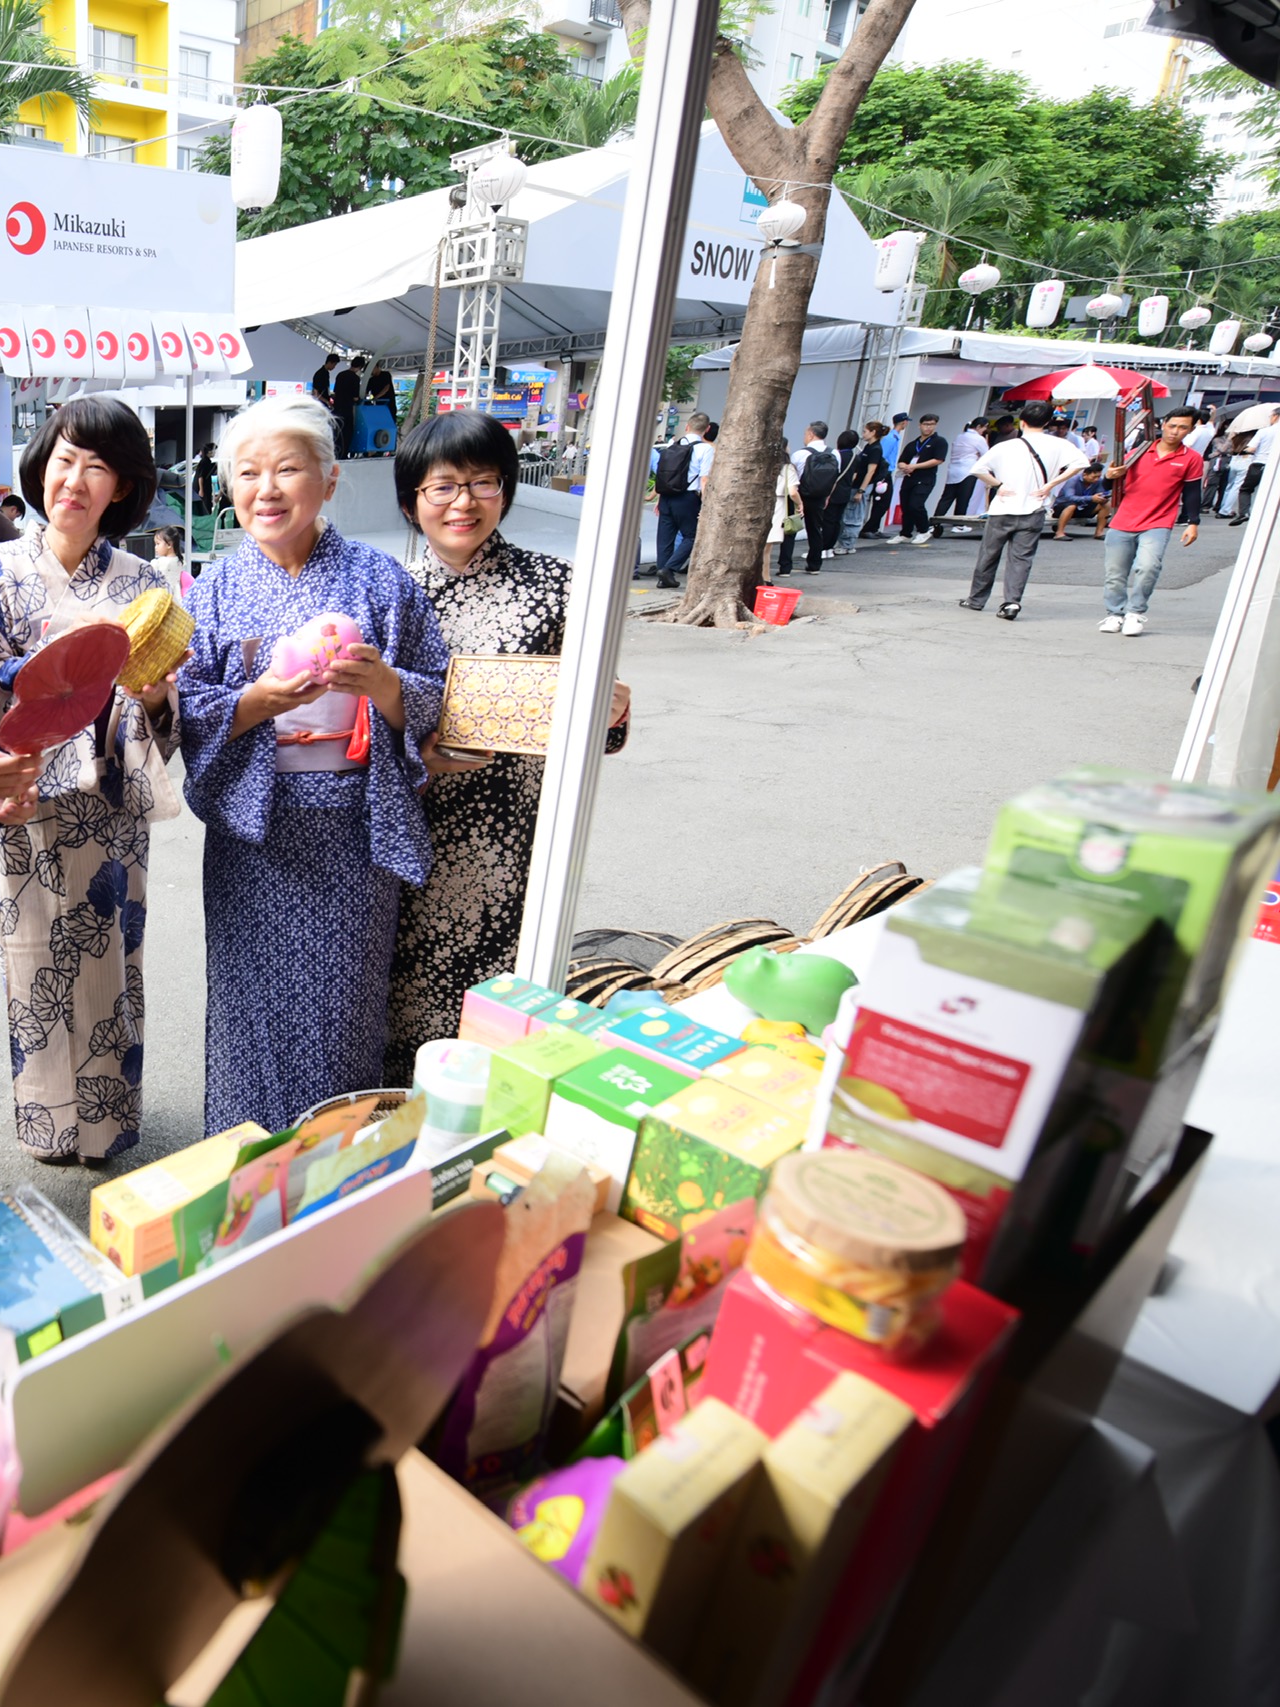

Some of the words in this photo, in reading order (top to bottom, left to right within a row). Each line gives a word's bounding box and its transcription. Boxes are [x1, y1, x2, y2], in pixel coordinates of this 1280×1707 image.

[53, 212, 126, 239] Mikazuki
[53, 240, 95, 253] JAPANESE
[96, 244, 134, 257] RESORTS
[135, 247, 142, 257] &
[143, 248, 157, 259] SPA
[690, 240, 754, 282] SNOW
